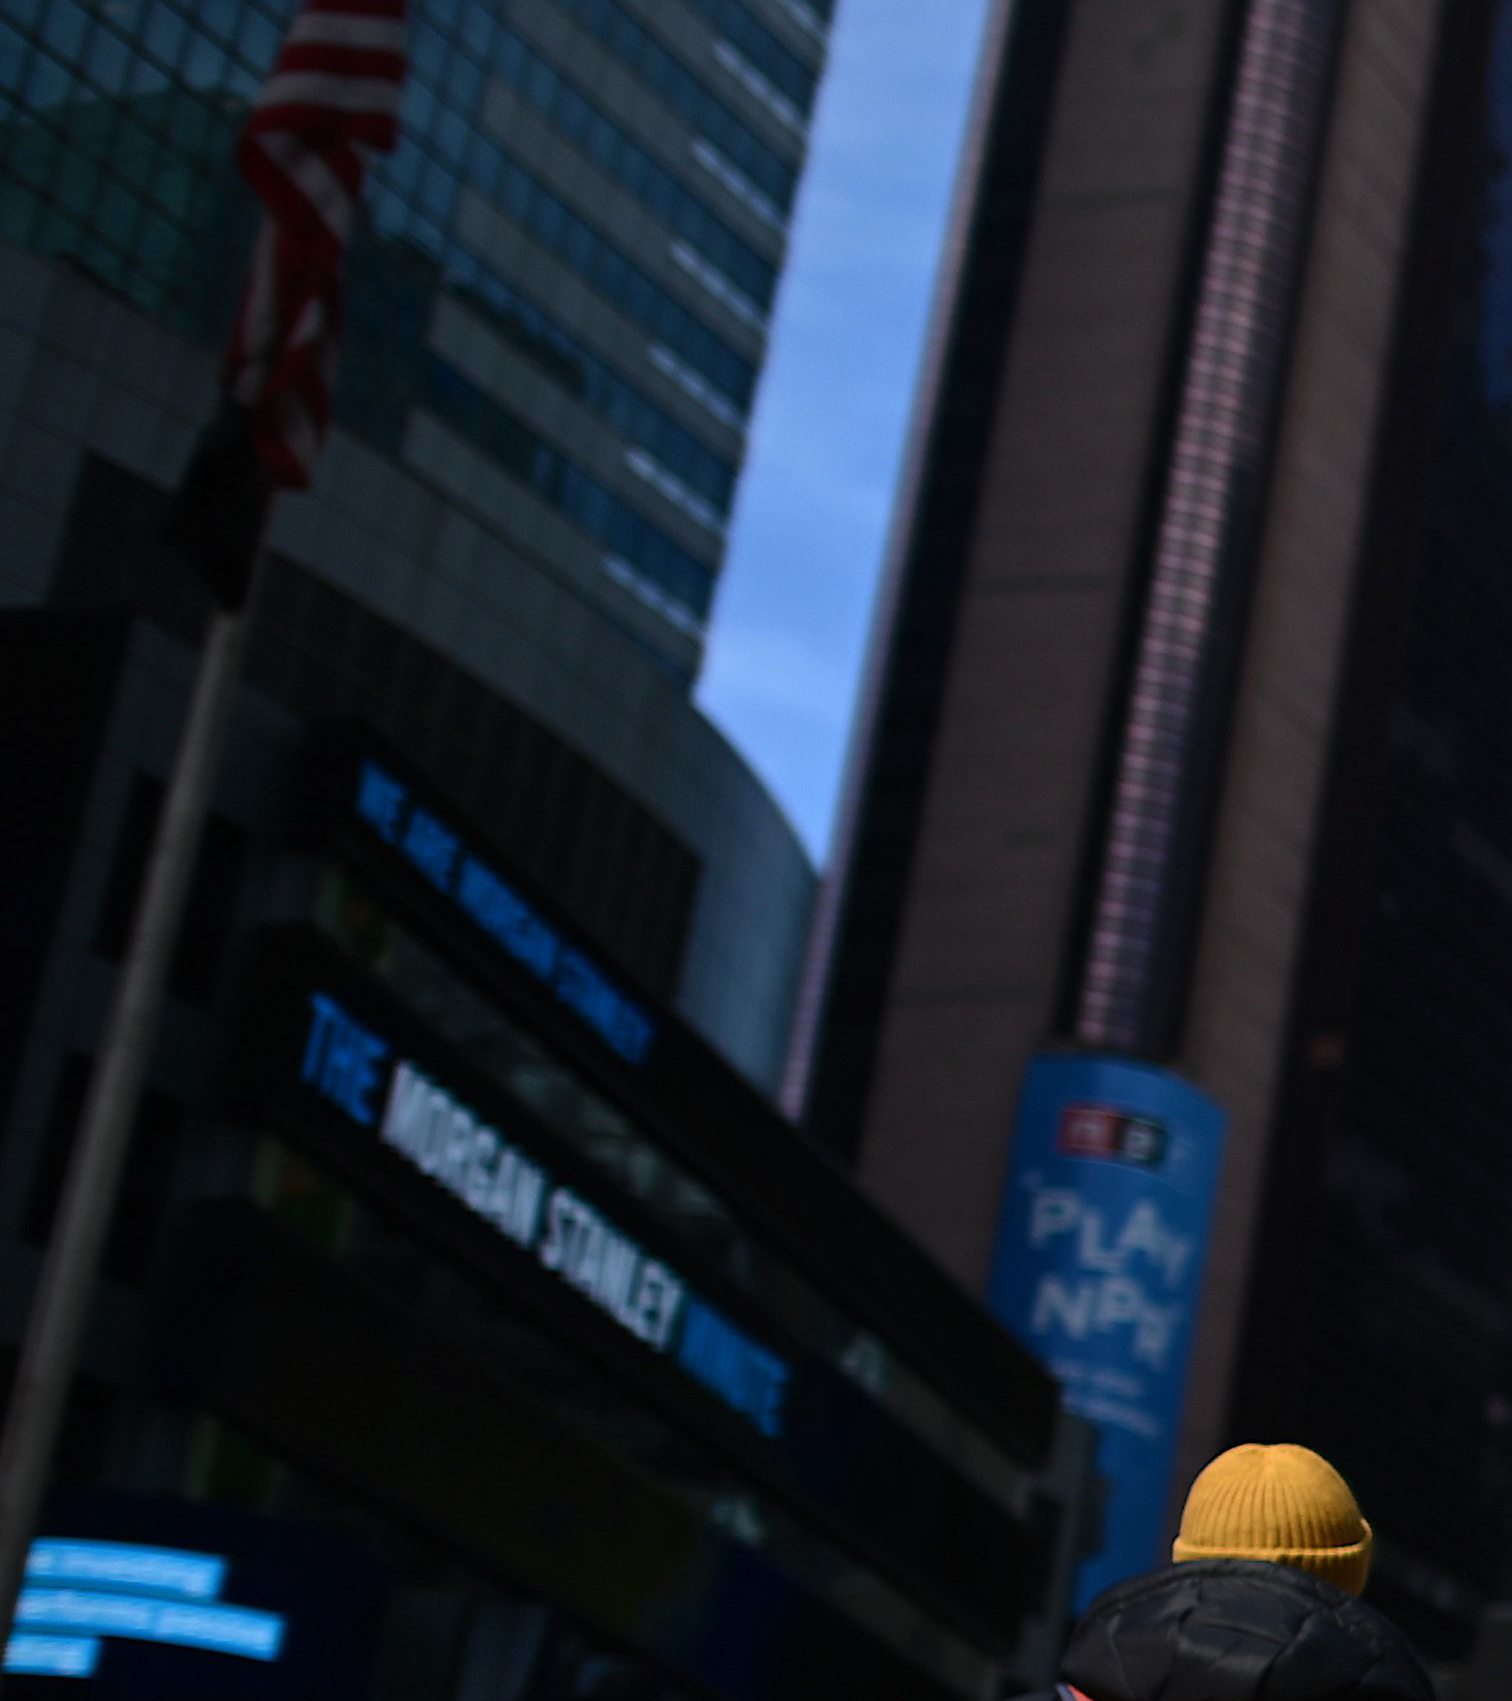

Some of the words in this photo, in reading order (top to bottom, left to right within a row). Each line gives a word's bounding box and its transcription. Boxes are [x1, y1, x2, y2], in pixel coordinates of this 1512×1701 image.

[457, 849, 562, 991] MORGAN
[553, 940, 662, 1069] STANLEY
[301, 988, 392, 1129] THE
[379, 1056, 551, 1252] MORGAN
[537, 1184, 687, 1354] STANLEY
[1028, 1187, 1197, 1293] PLAY
[1029, 1269, 1184, 1373] NPR
